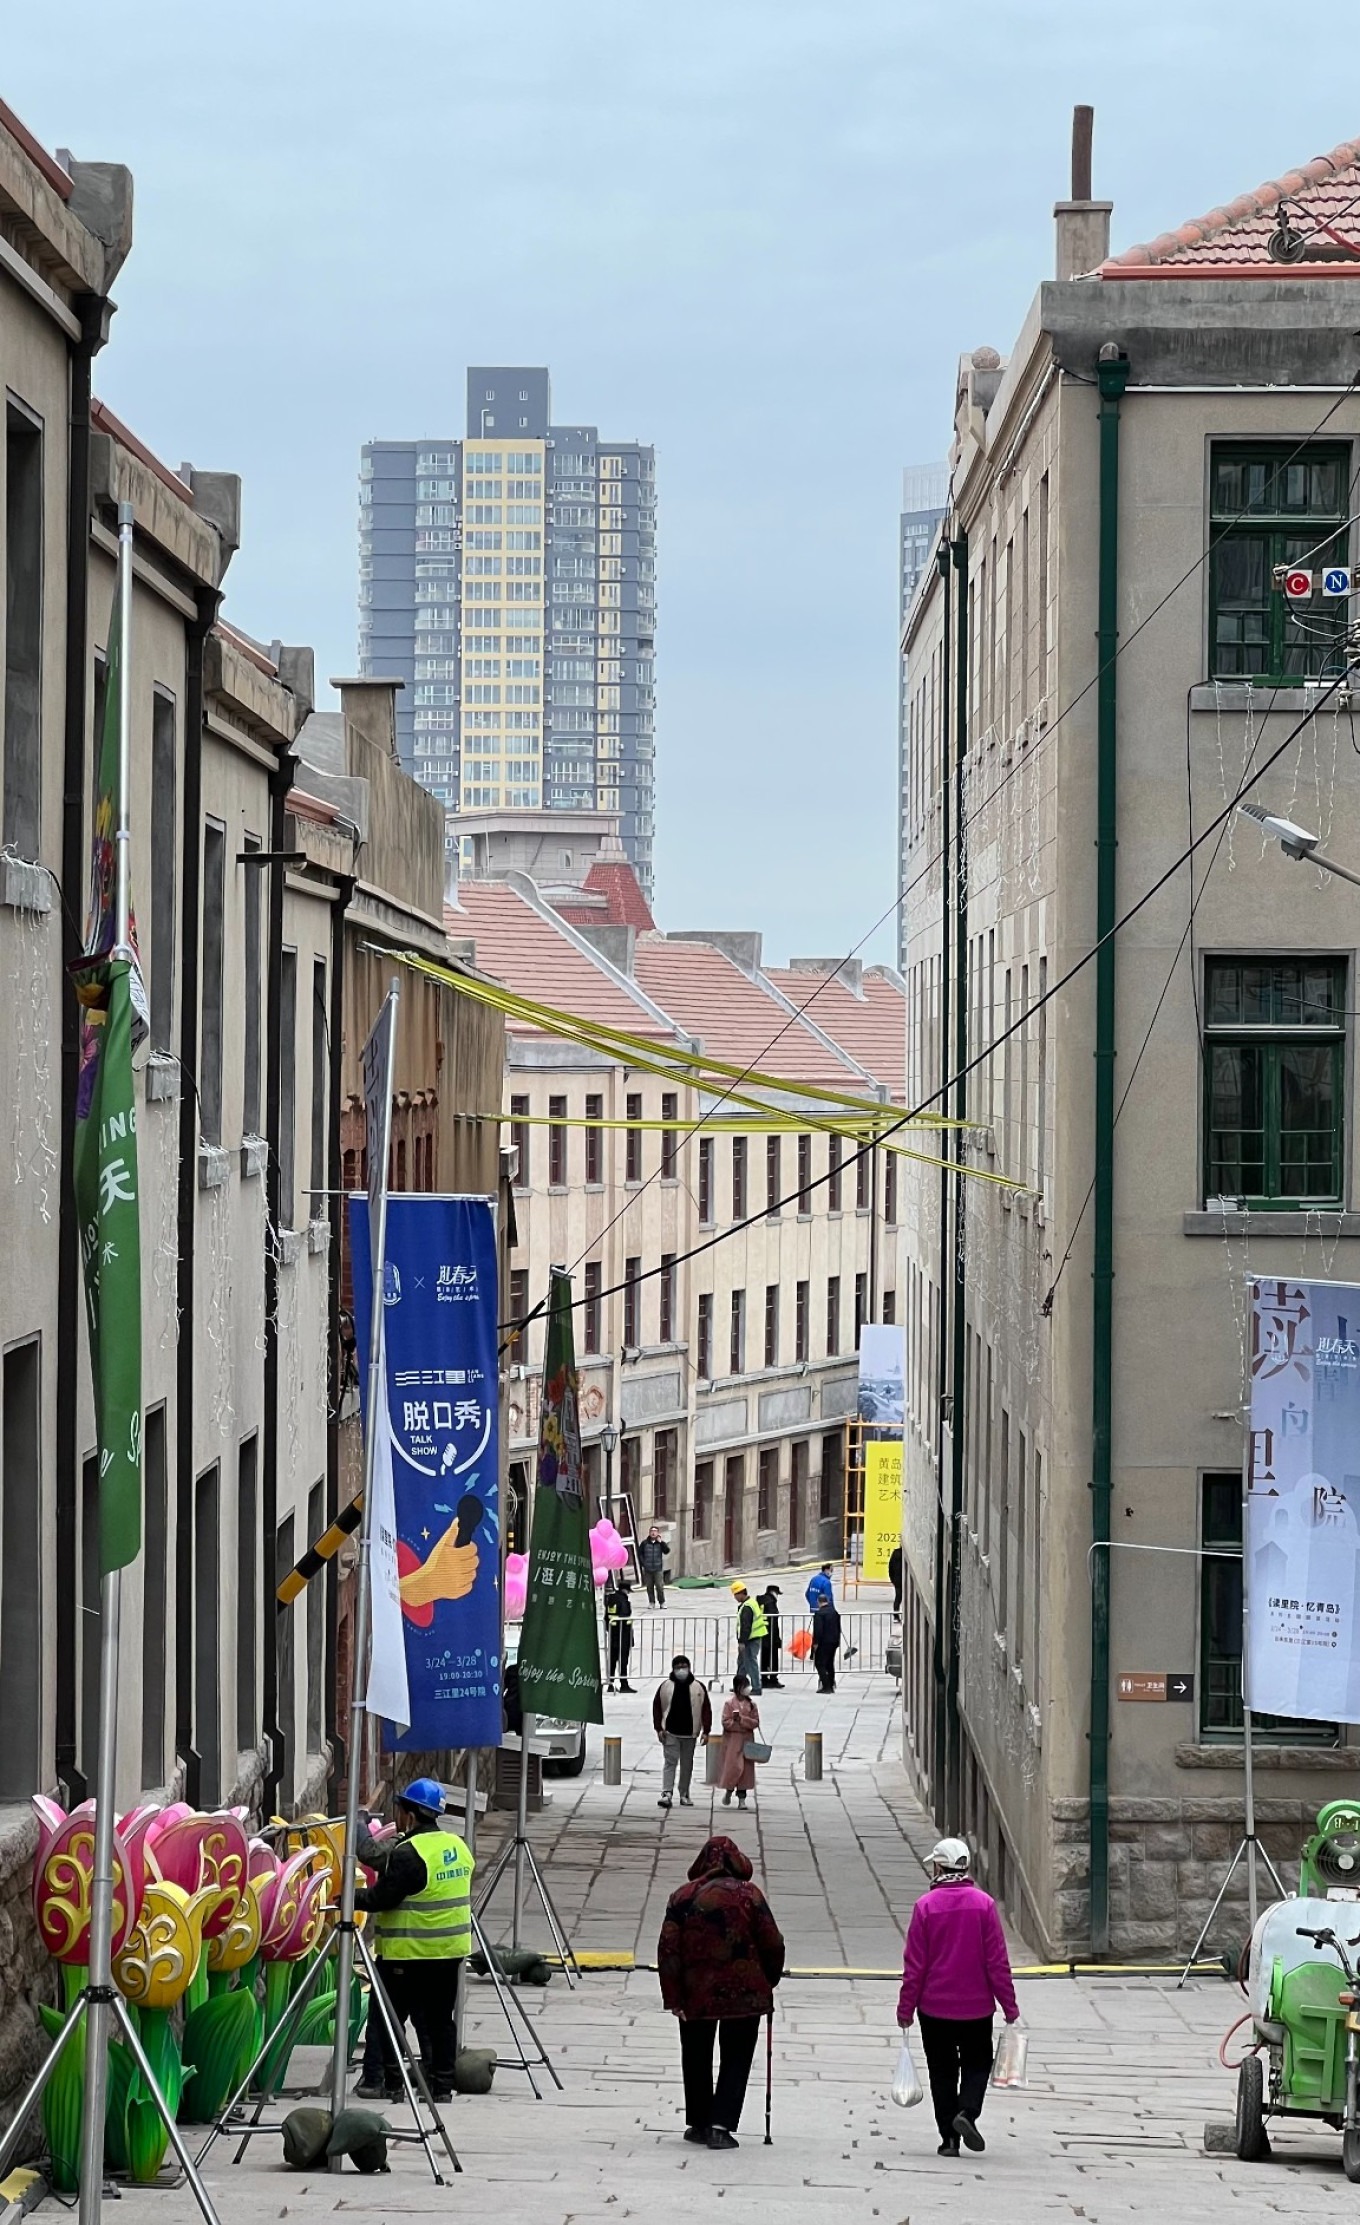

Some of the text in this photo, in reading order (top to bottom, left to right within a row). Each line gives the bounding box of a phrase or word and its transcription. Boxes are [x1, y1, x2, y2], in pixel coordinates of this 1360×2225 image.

[1291, 577, 1304, 591] C
[1330, 575, 1343, 589] N
[99, 1107, 136, 1156] ING
[100, 1158, 136, 1216] 天
[403, 1399, 481, 1431] 脱口秀
[410, 1435, 433, 1444] TALK
[411, 1446, 438, 1456] SHOW
[537, 1549, 562, 1563] ENJOY
[518, 1659, 543, 1684] Enjoy
[545, 1668, 565, 1683] the
